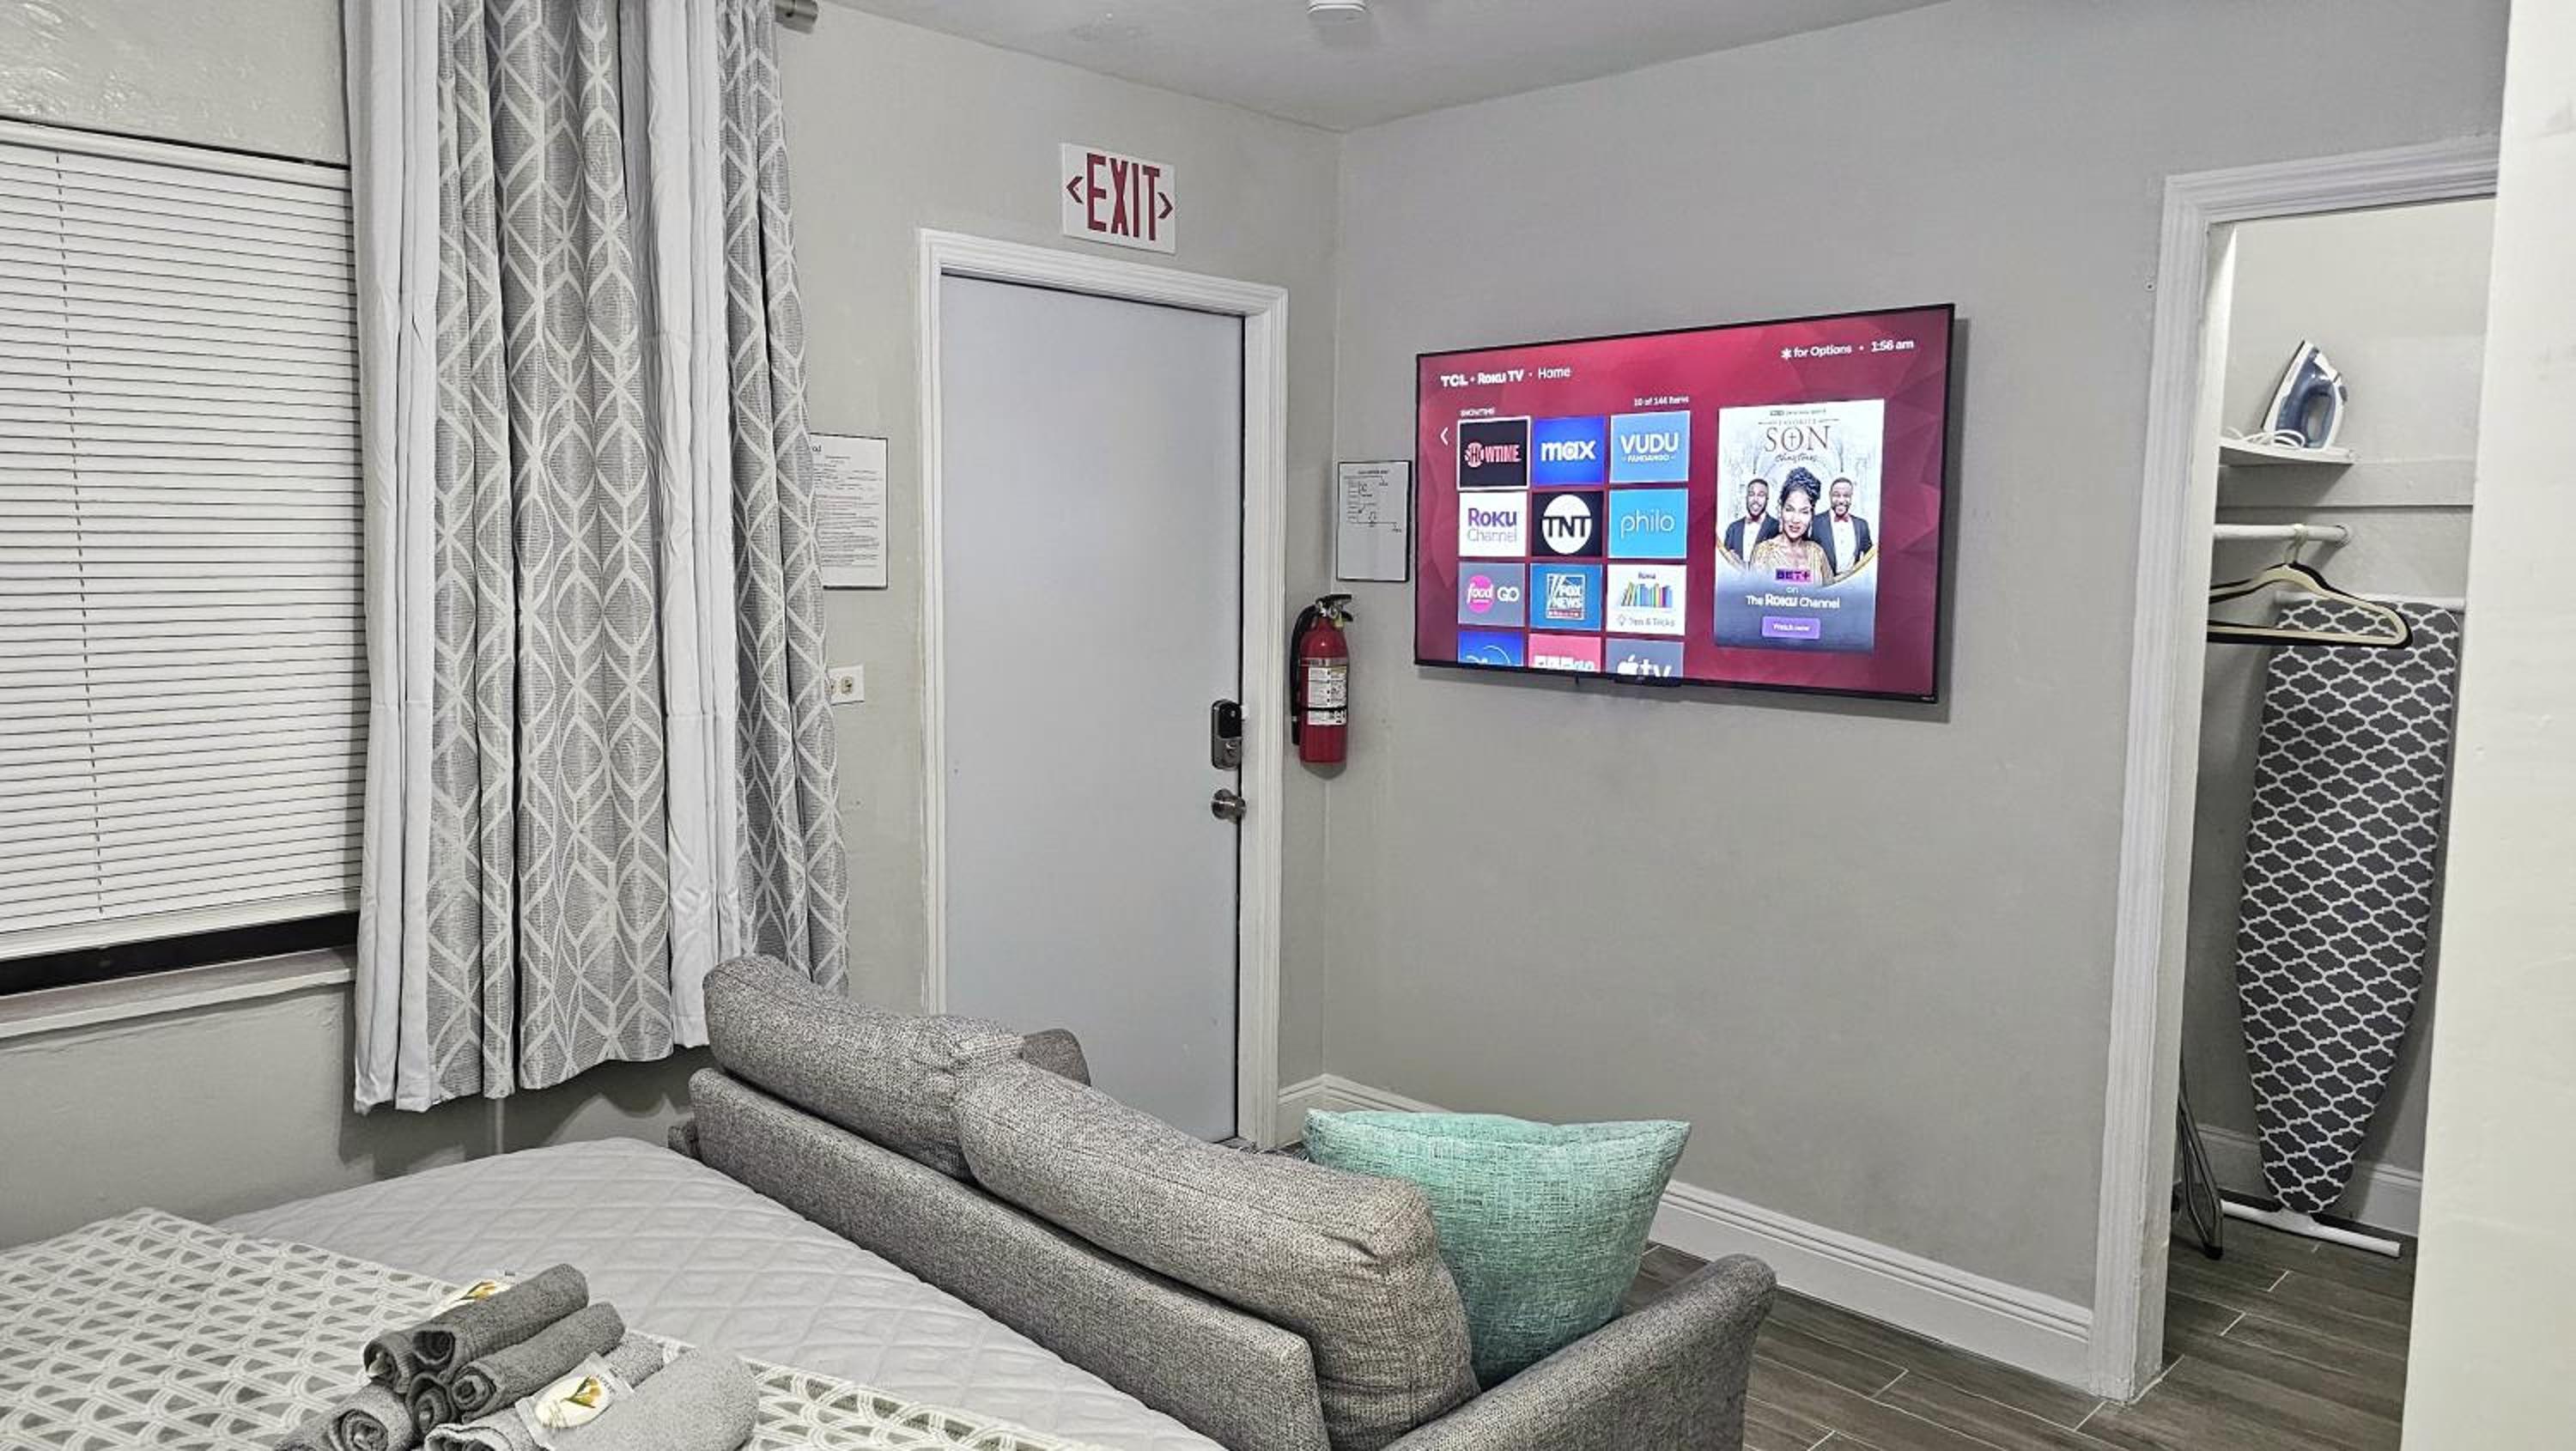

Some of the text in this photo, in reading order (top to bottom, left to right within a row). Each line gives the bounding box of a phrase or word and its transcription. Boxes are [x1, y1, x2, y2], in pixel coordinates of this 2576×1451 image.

[1086, 152, 1160, 241] EXIT
[1793, 344, 1852, 358] for Options
[1895, 340, 1915, 350] am
[1440, 374, 1469, 387] TCL
[1507, 368, 1525, 382] TV
[1538, 367, 1571, 379] Home
[1620, 432, 1679, 454] VUDU
[1765, 426, 1832, 452] SON
[1540, 440, 1596, 461] max
[1467, 507, 1517, 527] Roku
[1541, 515, 1592, 537] TNT
[1620, 508, 1675, 540] philo
[1467, 527, 1517, 543] Channel
[1467, 582, 1520, 604] food GO
[1558, 585, 1582, 597] FOX
[1551, 597, 1583, 610] NEWS
[1745, 595, 1765, 606] The
[1799, 596, 1840, 609] Channel
